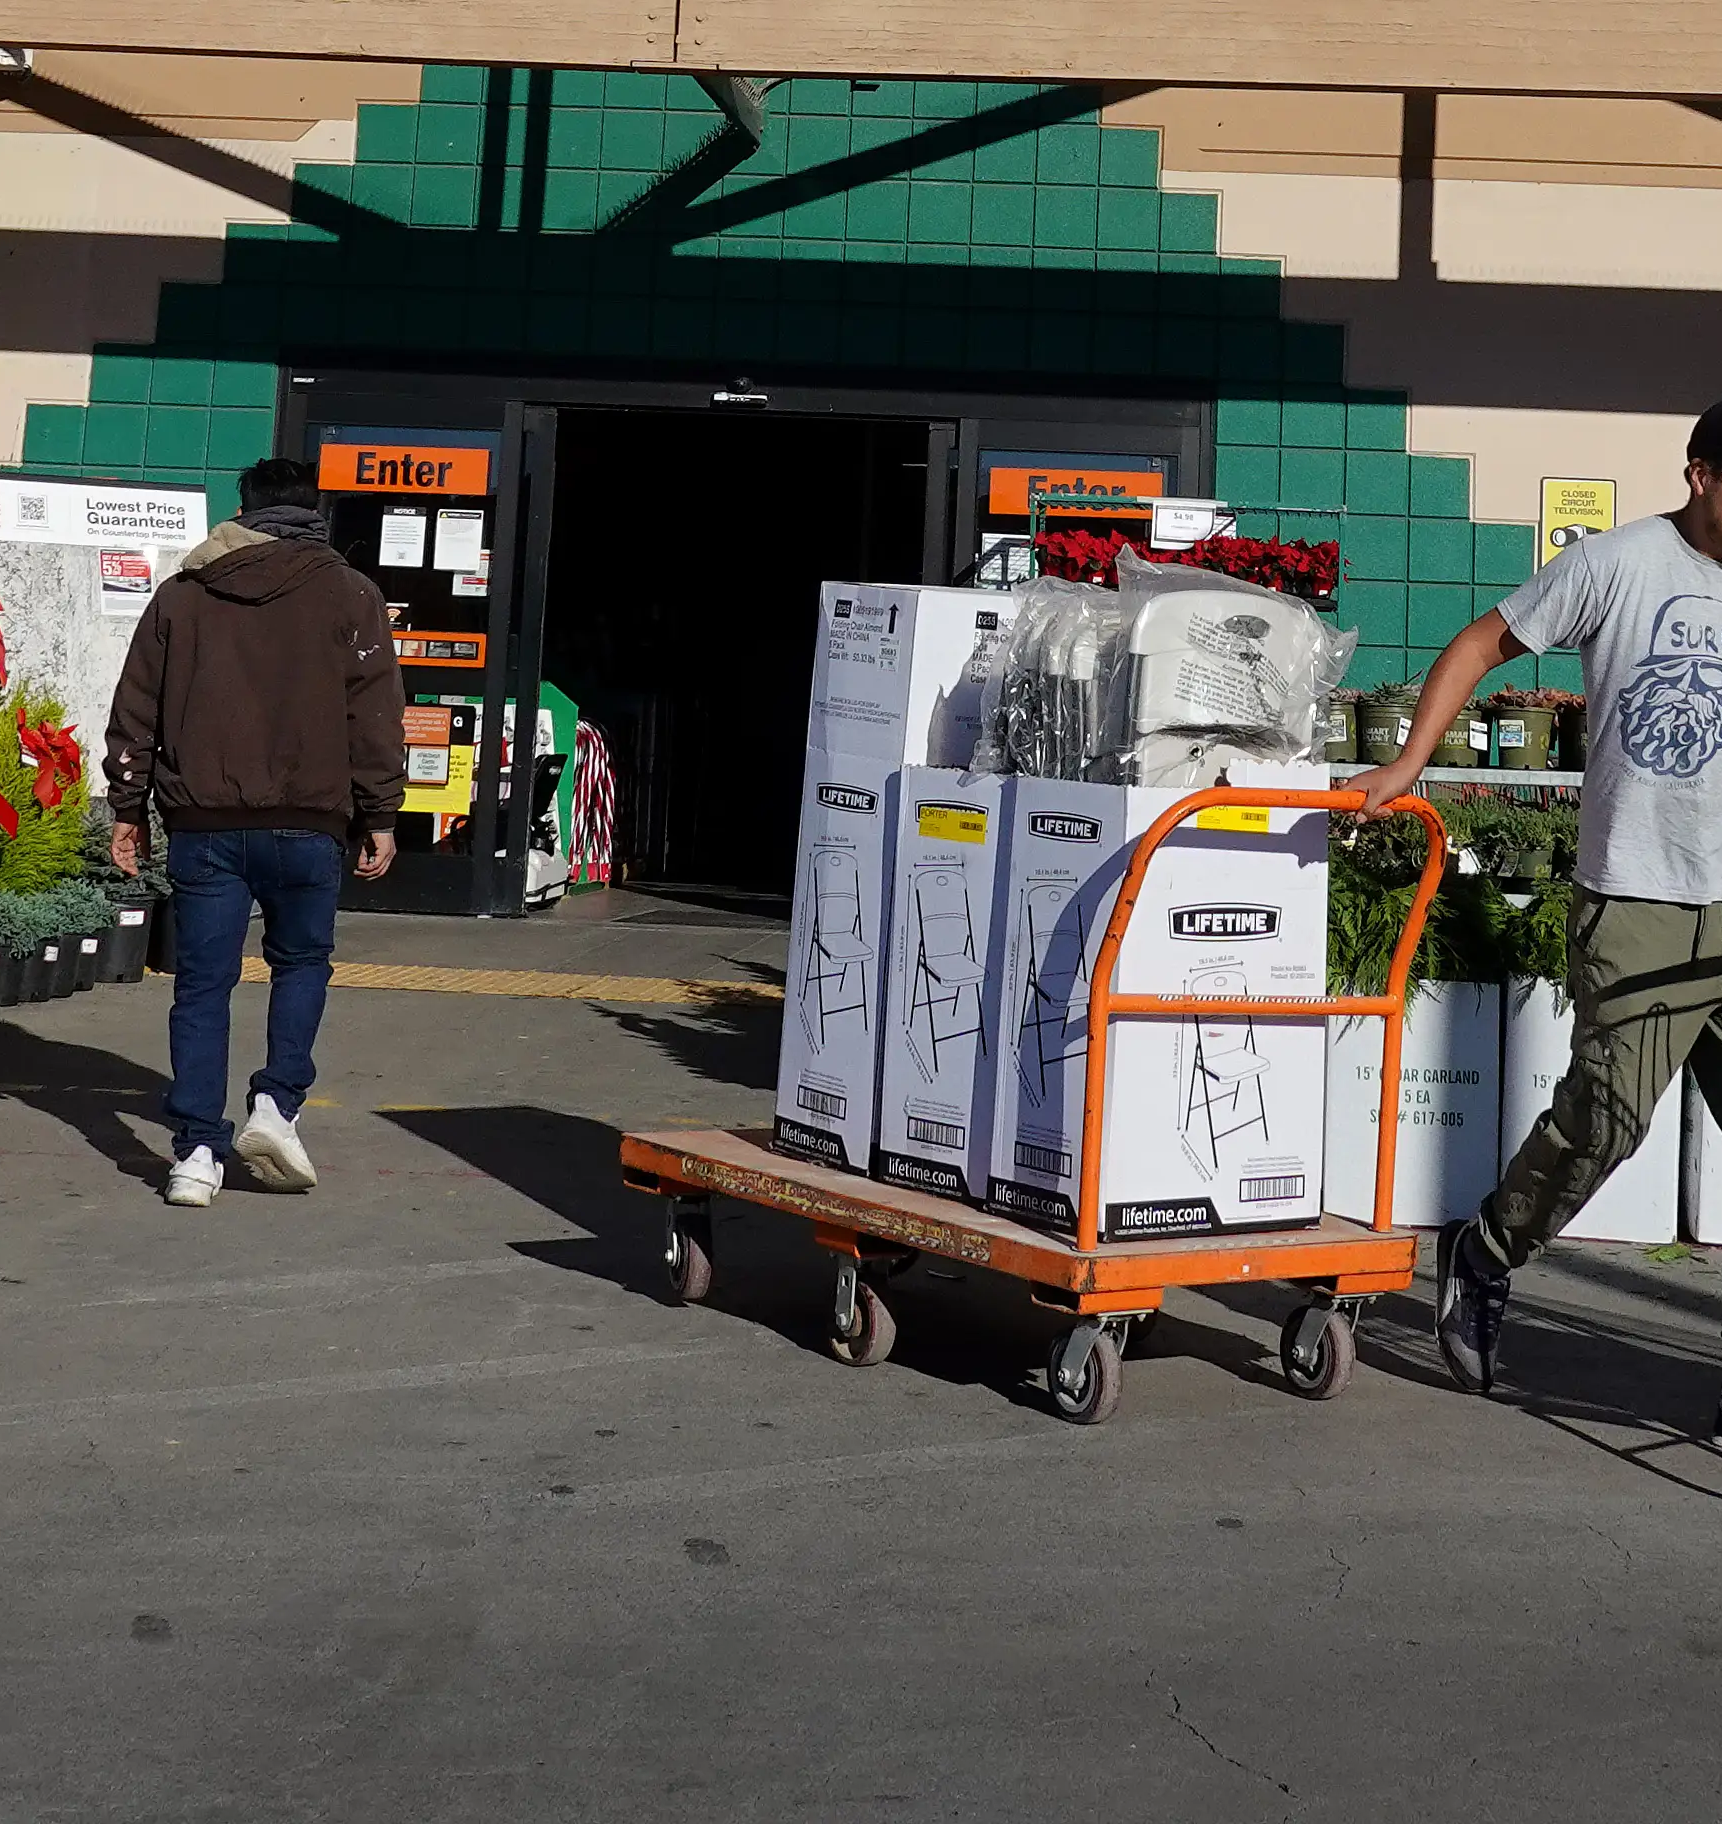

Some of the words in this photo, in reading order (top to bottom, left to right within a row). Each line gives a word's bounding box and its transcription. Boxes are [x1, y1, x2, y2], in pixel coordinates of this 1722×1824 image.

[356, 451, 453, 487] Enter
[1561, 490, 1596, 498] CLOSED
[1561, 499, 1596, 507] CIRCUIT
[86, 498, 141, 514] Lowest
[146, 502, 187, 517] Price
[1553, 507, 1603, 516] TELEVISION
[86, 511, 187, 531] Guaranteed
[87, 527, 100, 535] On
[101, 528, 150, 540] Countertop
[151, 531, 187, 541] Projects
[973, 652, 993, 663] MADE
[1445, 730, 1468, 738] SMAR
[822, 788, 870, 809] LIFETIME
[921, 807, 948, 819] PORTER
[1036, 817, 1093, 838] LIFETIME
[1182, 912, 1268, 933] LIFETIME
[1355, 1065, 1375, 1081] 15'
[1423, 1068, 1480, 1085] GARLAND
[1531, 1073, 1552, 1088] 15'
[1404, 1089, 1412, 1104] 5
[1416, 1090, 1430, 1104] EA
[1413, 1111, 1464, 1127] 617-005
[780, 1122, 839, 1156] lifetime.com
[888, 1156, 957, 1188] lifetime.com
[995, 1183, 1067, 1217] lifetime.com
[1122, 1206, 1207, 1226] lifetime.com
